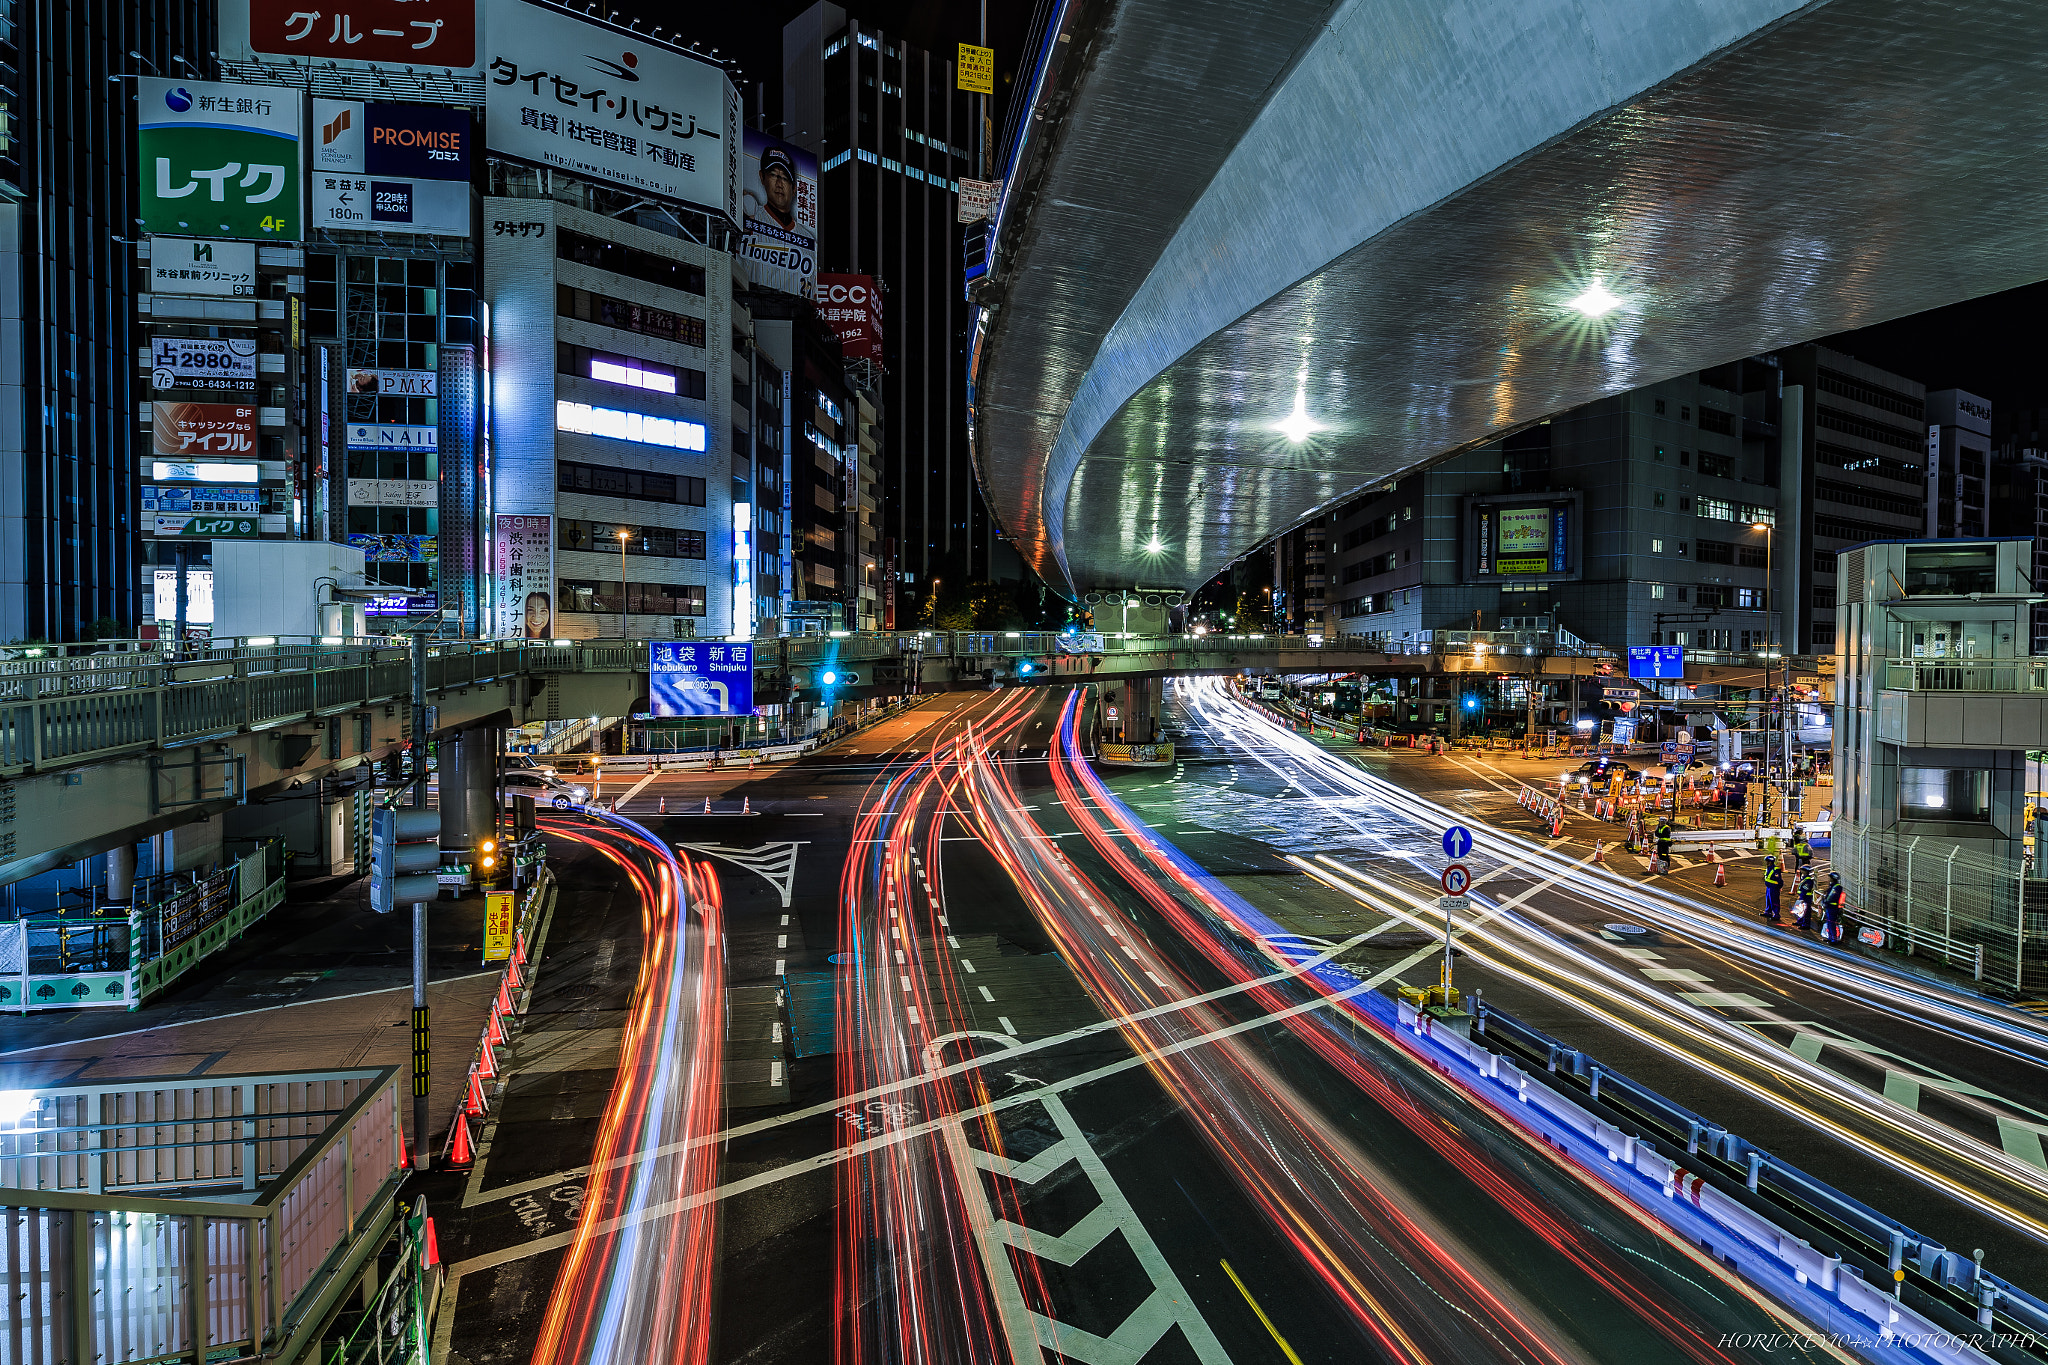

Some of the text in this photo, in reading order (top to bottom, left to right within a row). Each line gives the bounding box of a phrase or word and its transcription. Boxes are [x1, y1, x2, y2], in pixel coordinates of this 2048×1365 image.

[284, 11, 444, 50] グループ
[198, 95, 273, 116] 新生銀行
[489, 56, 721, 140] タイセイ・ハウジー
[373, 127, 461, 150] PROMISE
[519, 106, 696, 173] 賃貸 社宅管理 不動産
[428, 150, 461, 162] プロミス
[156, 156, 286, 204] レイク
[543, 151, 678, 195] http://www.taisei-hs.co.jp/
[324, 178, 367, 192] 宮益坂
[797, 180, 809, 225] 募集中
[328, 207, 364, 220] 180m
[259, 215, 286, 232] 4F
[492, 220, 546, 239] タキサワ
[156, 268, 250, 283] 渋谷駅前クリニック
[816, 284, 867, 304] ECC
[841, 328, 863, 339] 1962
[156, 342, 178, 367] 占
[181, 352, 241, 370] 2980円
[155, 373, 171, 387] 7F
[192, 379, 255, 390] 03-6434-1212
[383, 377, 433, 394] PMK
[236, 408, 252, 417] 6F
[178, 420, 251, 431] キャッシングなら
[177, 431, 252, 452] アイフル
[381, 430, 436, 445] NAIL
[194, 493, 256, 501] とことんこだわる
[195, 519, 235, 533] レイク
[509, 531, 524, 638] 渋谷歯科タナカ
[656, 646, 748, 662] 池袋 新宿
[1662, 647, 1679, 655] 三田
[653, 662, 748, 673] Ikebukuro Shinjuku
[695, 681, 709, 689] 305
[1442, 899, 1469, 908] ここから
[488, 911, 499, 936] 出入口
[500, 896, 510, 935] 工事用車両
